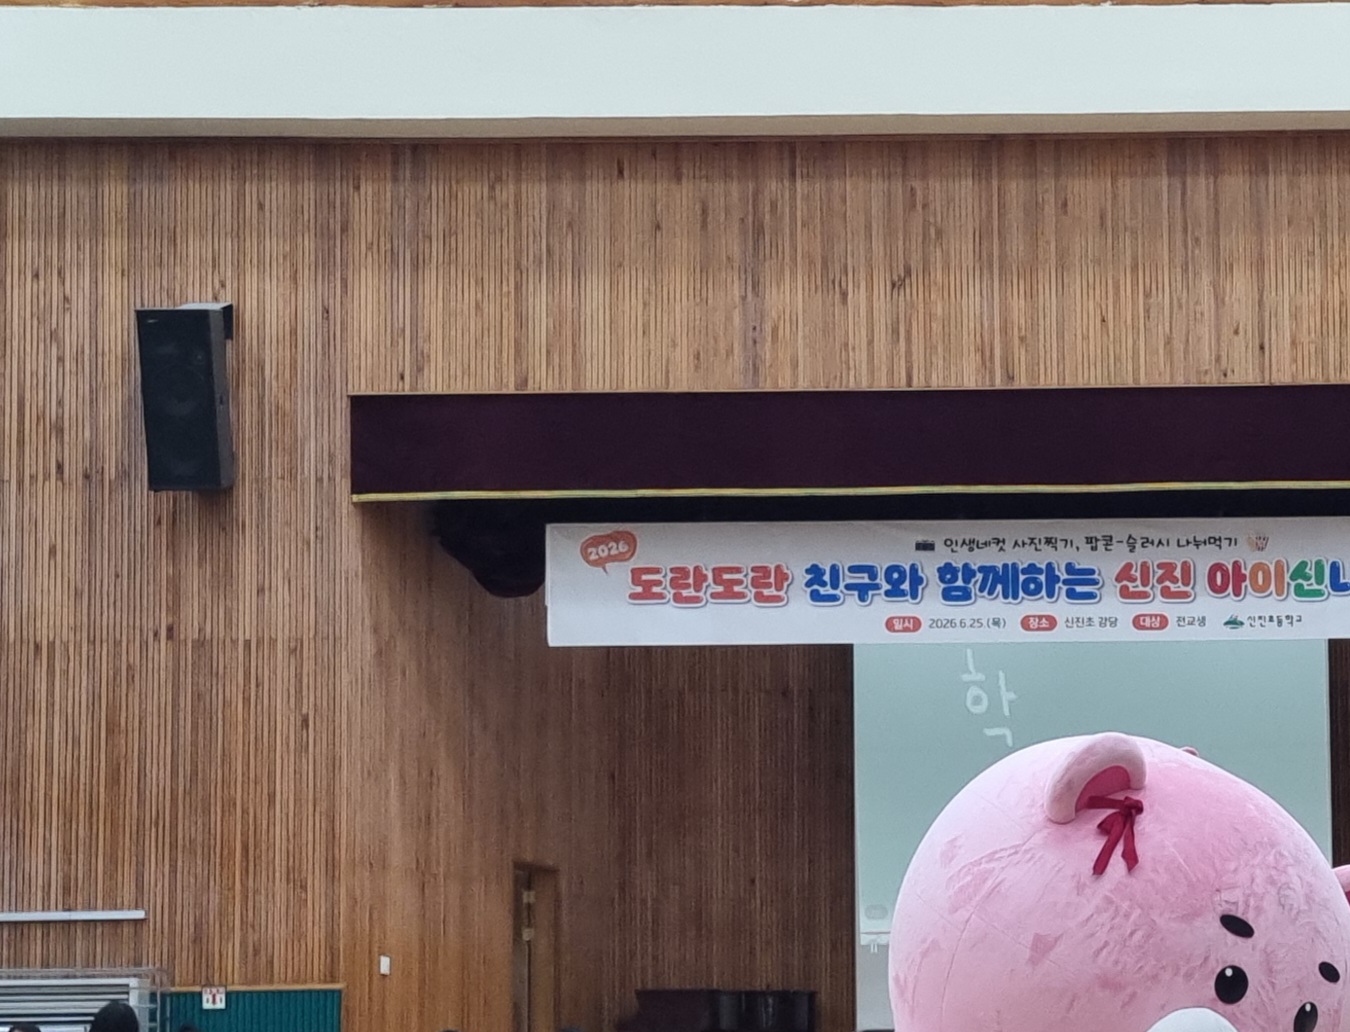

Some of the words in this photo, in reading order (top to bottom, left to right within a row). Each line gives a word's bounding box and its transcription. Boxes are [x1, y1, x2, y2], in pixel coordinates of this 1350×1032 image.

[587, 539, 630, 561] 2026
[943, 536, 1006, 553] 인생네컷
[1012, 536, 1080, 553] 사진찍기,
[1084, 534, 1170, 553] 팝콘-슬러시
[1176, 534, 1238, 551] 나눠먹기
[627, 564, 791, 605] 도란도란
[803, 562, 926, 604] 친구와
[936, 561, 1101, 603] 함께하는
[1114, 559, 1196, 600] 신진
[892, 617, 914, 631] 일시
[1027, 616, 1050, 630] 장소
[1063, 615, 1096, 629] 신진초
[1097, 615, 1119, 629] 강당
[1138, 615, 1162, 629] 대상
[1175, 615, 1207, 628] 전교생
